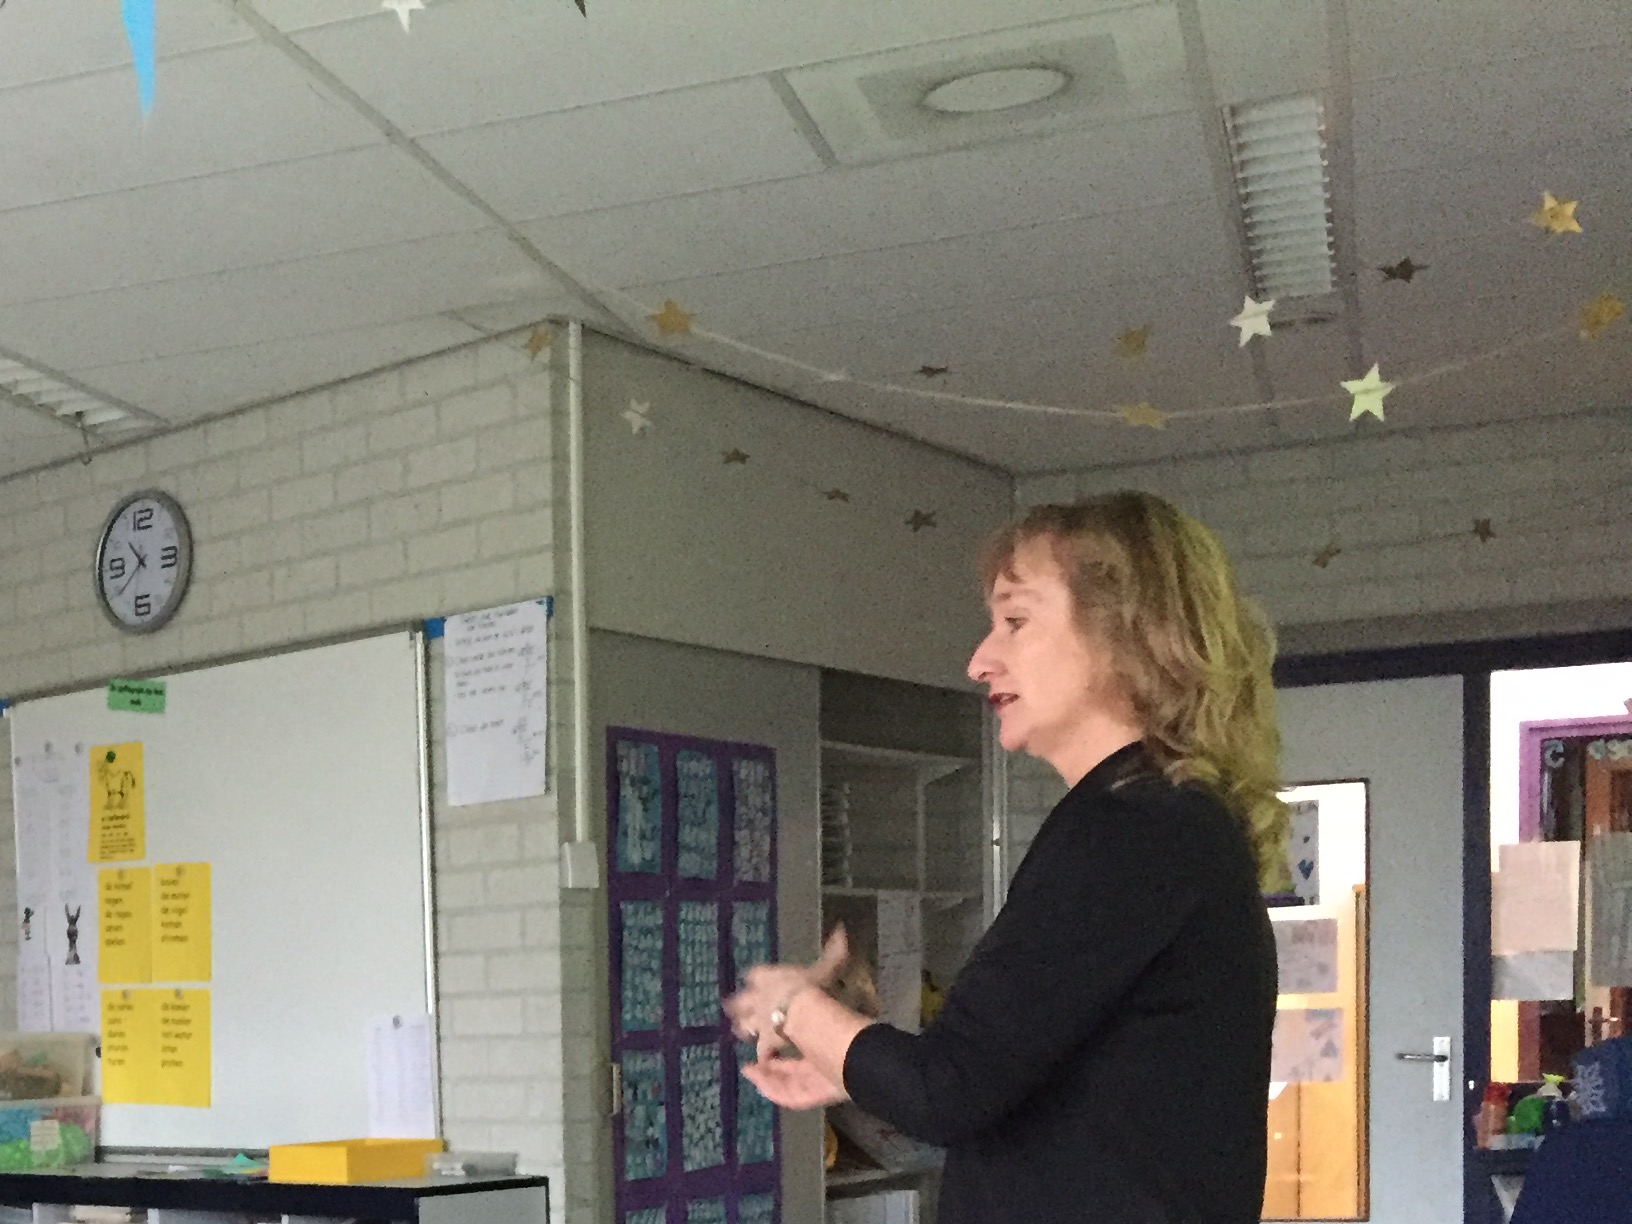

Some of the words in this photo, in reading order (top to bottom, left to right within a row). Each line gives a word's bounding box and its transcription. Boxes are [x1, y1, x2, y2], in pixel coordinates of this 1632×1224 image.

[132, 507, 154, 532] 12
[109, 557, 126, 580] 9
[160, 545, 178, 569] 3
[134, 593, 151, 617] 6
